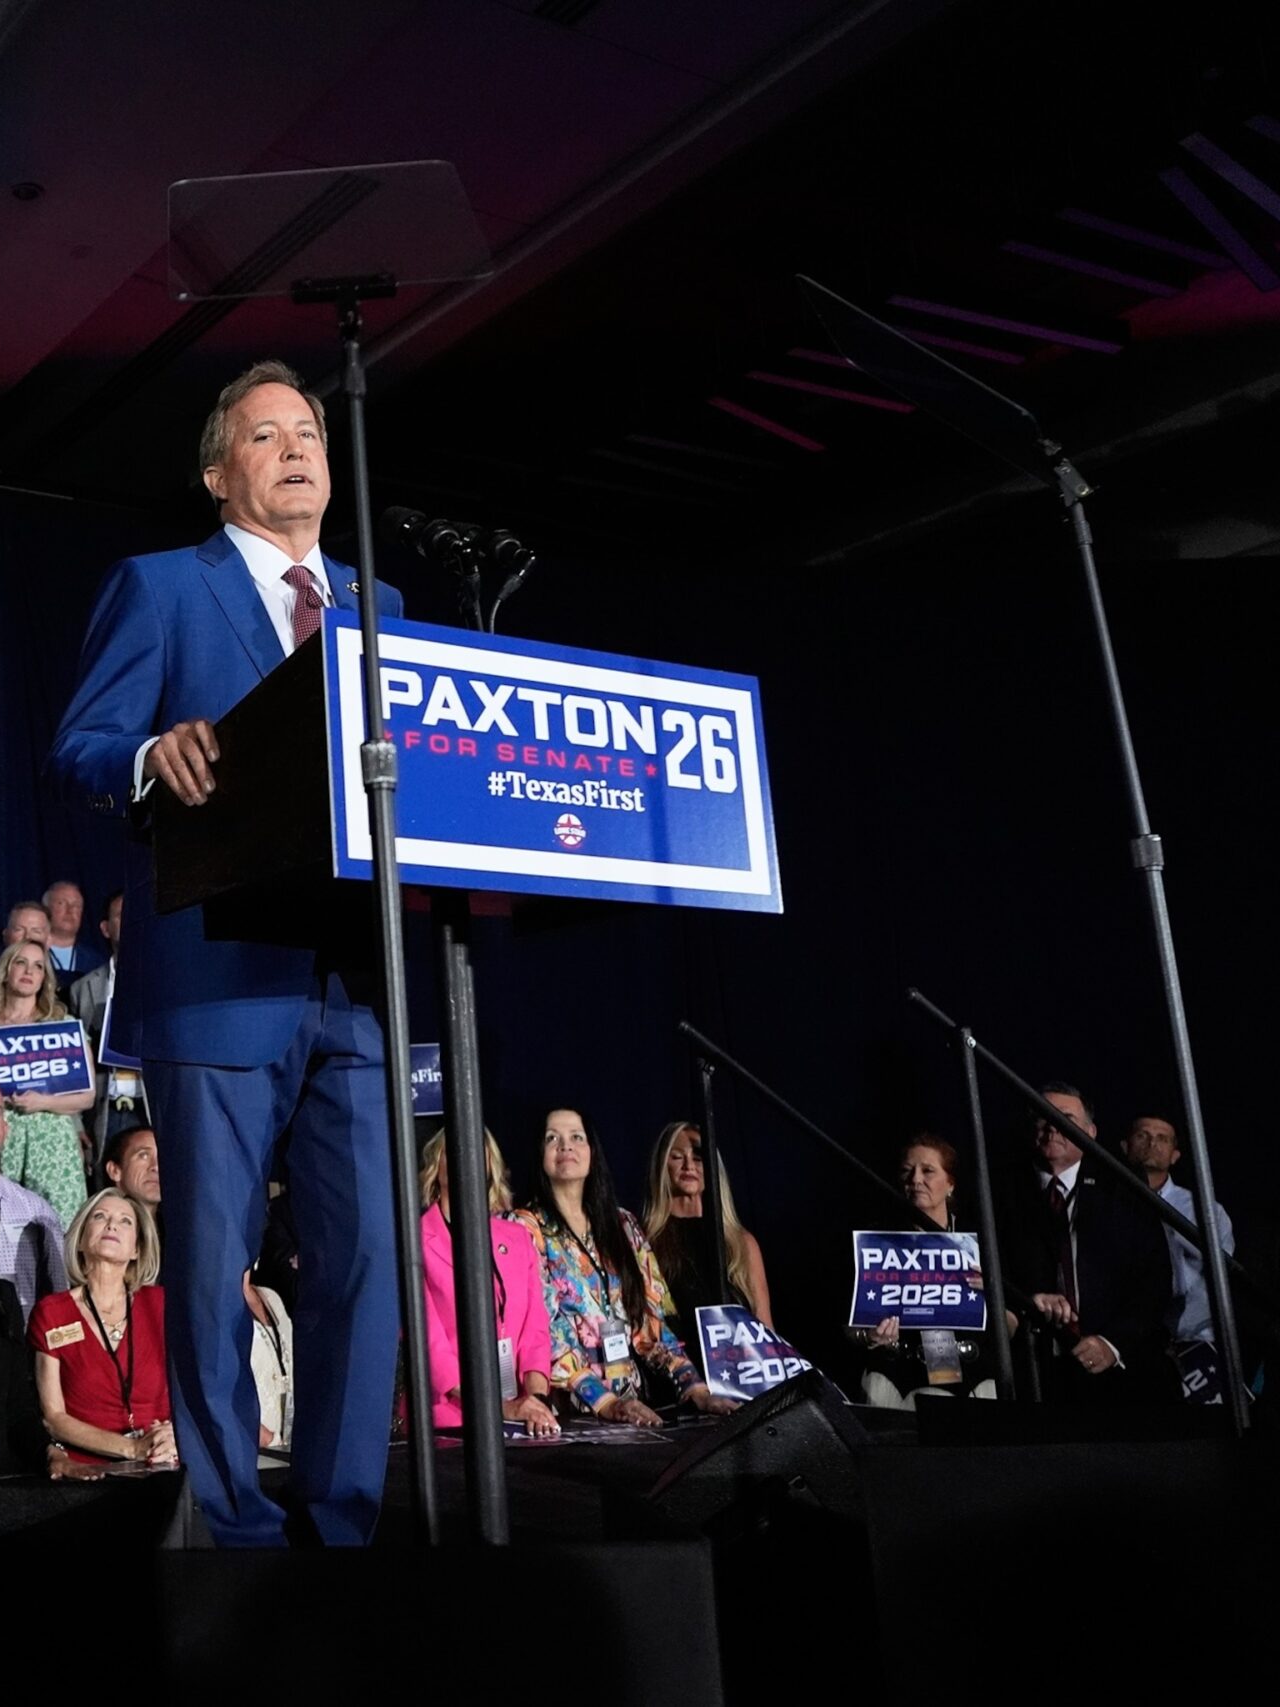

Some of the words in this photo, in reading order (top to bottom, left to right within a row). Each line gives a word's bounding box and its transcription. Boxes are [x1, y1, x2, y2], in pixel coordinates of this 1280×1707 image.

[380, 666, 657, 755] PAXTON
[661, 708, 738, 794] 26
[405, 731, 478, 757] FOR
[497, 743, 636, 777] SENATE
[487, 771, 645, 813] #TexasFirst
[861, 1248, 980, 1270] PAXTON
[863, 1272, 900, 1282] FOR
[881, 1284, 962, 1306] 2026
